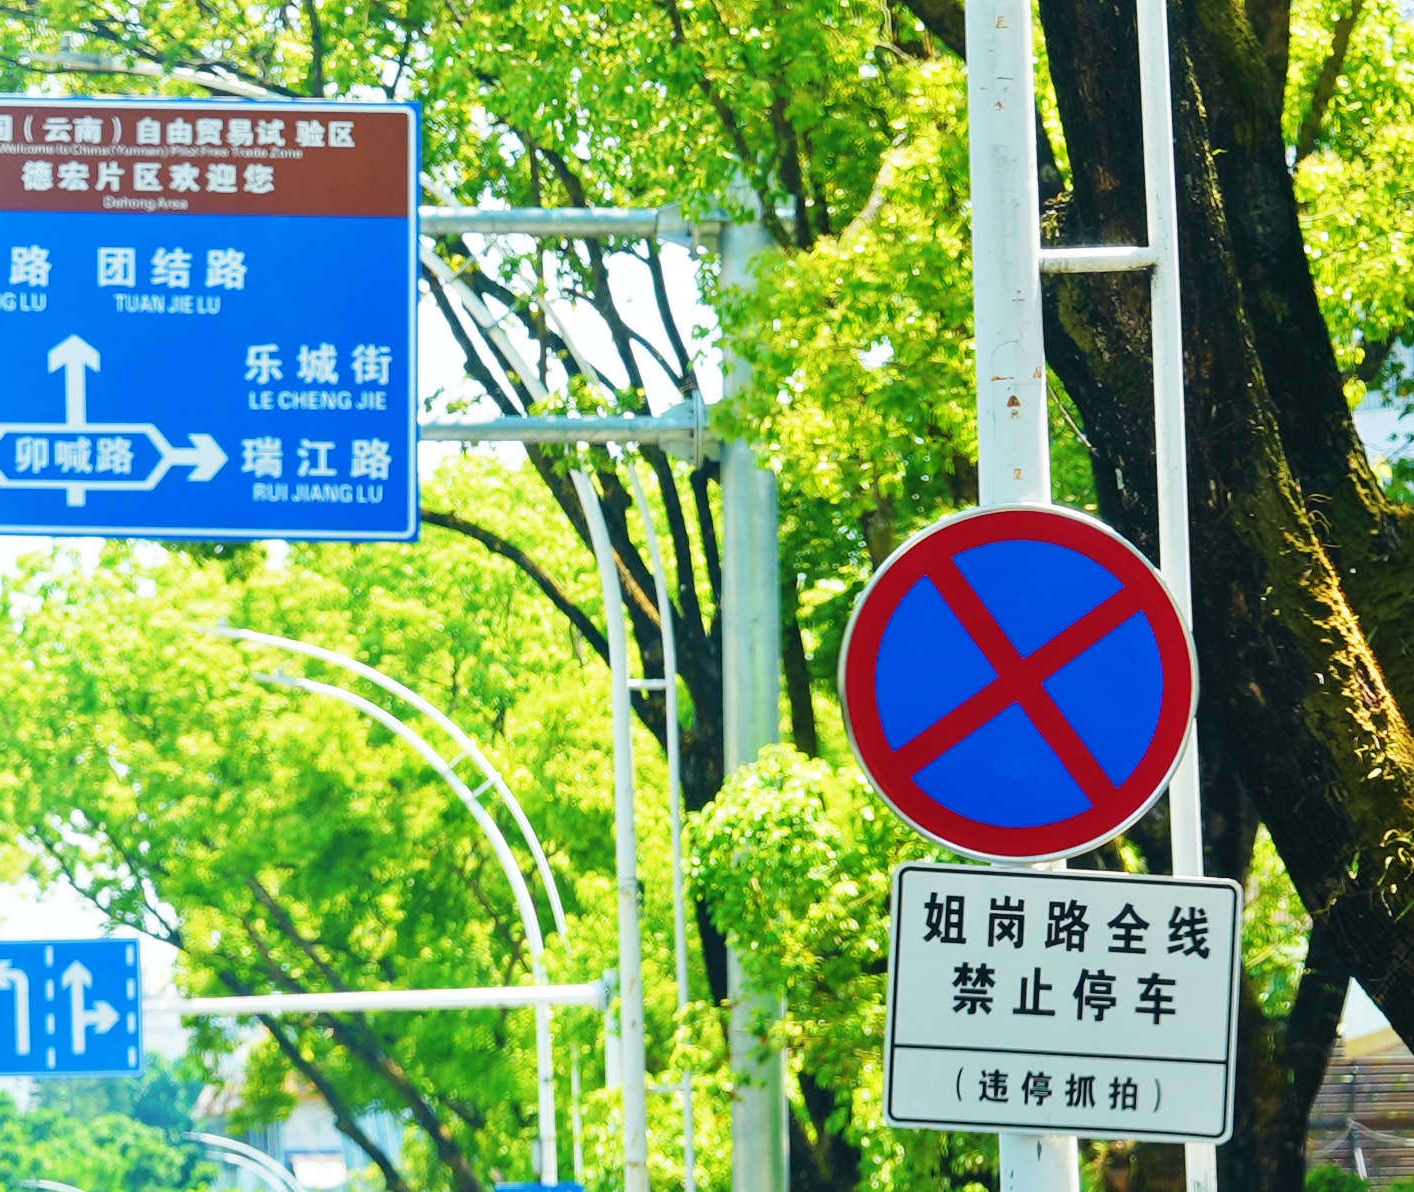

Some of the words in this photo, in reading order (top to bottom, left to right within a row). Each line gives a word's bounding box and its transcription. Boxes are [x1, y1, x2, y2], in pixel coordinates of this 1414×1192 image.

[269, 146, 303, 159] Zone
[21, 160, 275, 194] 德宏片区欢迎您
[97, 246, 248, 290] 团结路
[19, 293, 47, 312] LU
[113, 292, 165, 313] TUAN
[166, 294, 194, 314] JIE
[196, 295, 222, 315] LU
[244, 342, 393, 386] 乐城街
[248, 390, 275, 410] LE
[277, 390, 352, 410] CHENG
[354, 391, 388, 410] JIE
[241, 436, 393, 481] 瑞江路
[253, 483, 288, 502] RUI
[290, 484, 354, 503] JIANG
[356, 484, 384, 503] LU
[923, 892, 1211, 959] 姐岗路全线
[952, 962, 1177, 1025] 禁止停车
[956, 1066, 1162, 1113] （违停抓拍）
